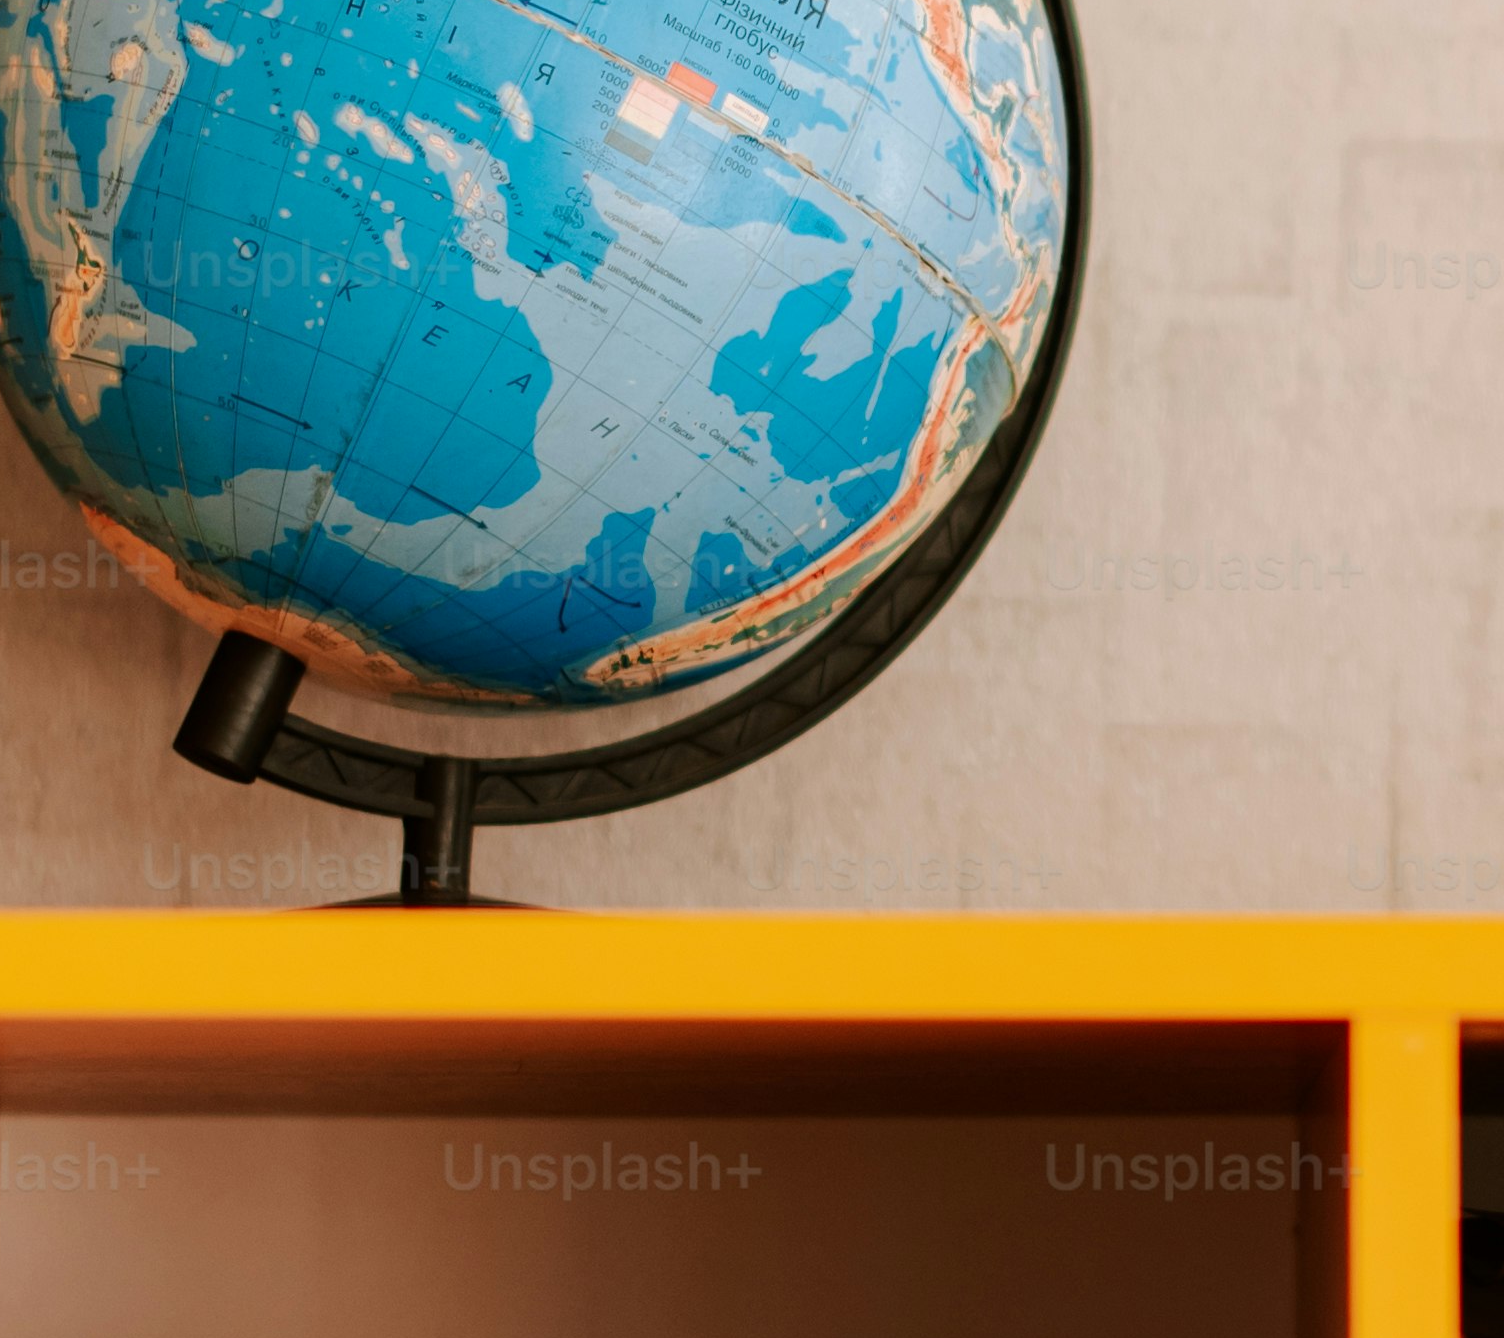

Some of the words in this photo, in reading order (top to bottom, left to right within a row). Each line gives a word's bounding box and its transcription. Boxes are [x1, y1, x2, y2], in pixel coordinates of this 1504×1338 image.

[715, 13, 780, 61] глобус
[636, 54, 667, 76] 5000
[663, 13, 722, 53] Масштаб
[726, 48, 751, 71] 1:60
[753, 62, 777, 87] 000
[778, 78, 800, 101] 000
[599, 69, 629, 92] 1000
[598, 86, 622, 104] 500
[591, 100, 616, 118] 200
[730, 144, 758, 166] 4000
[723, 157, 752, 179] 6000
